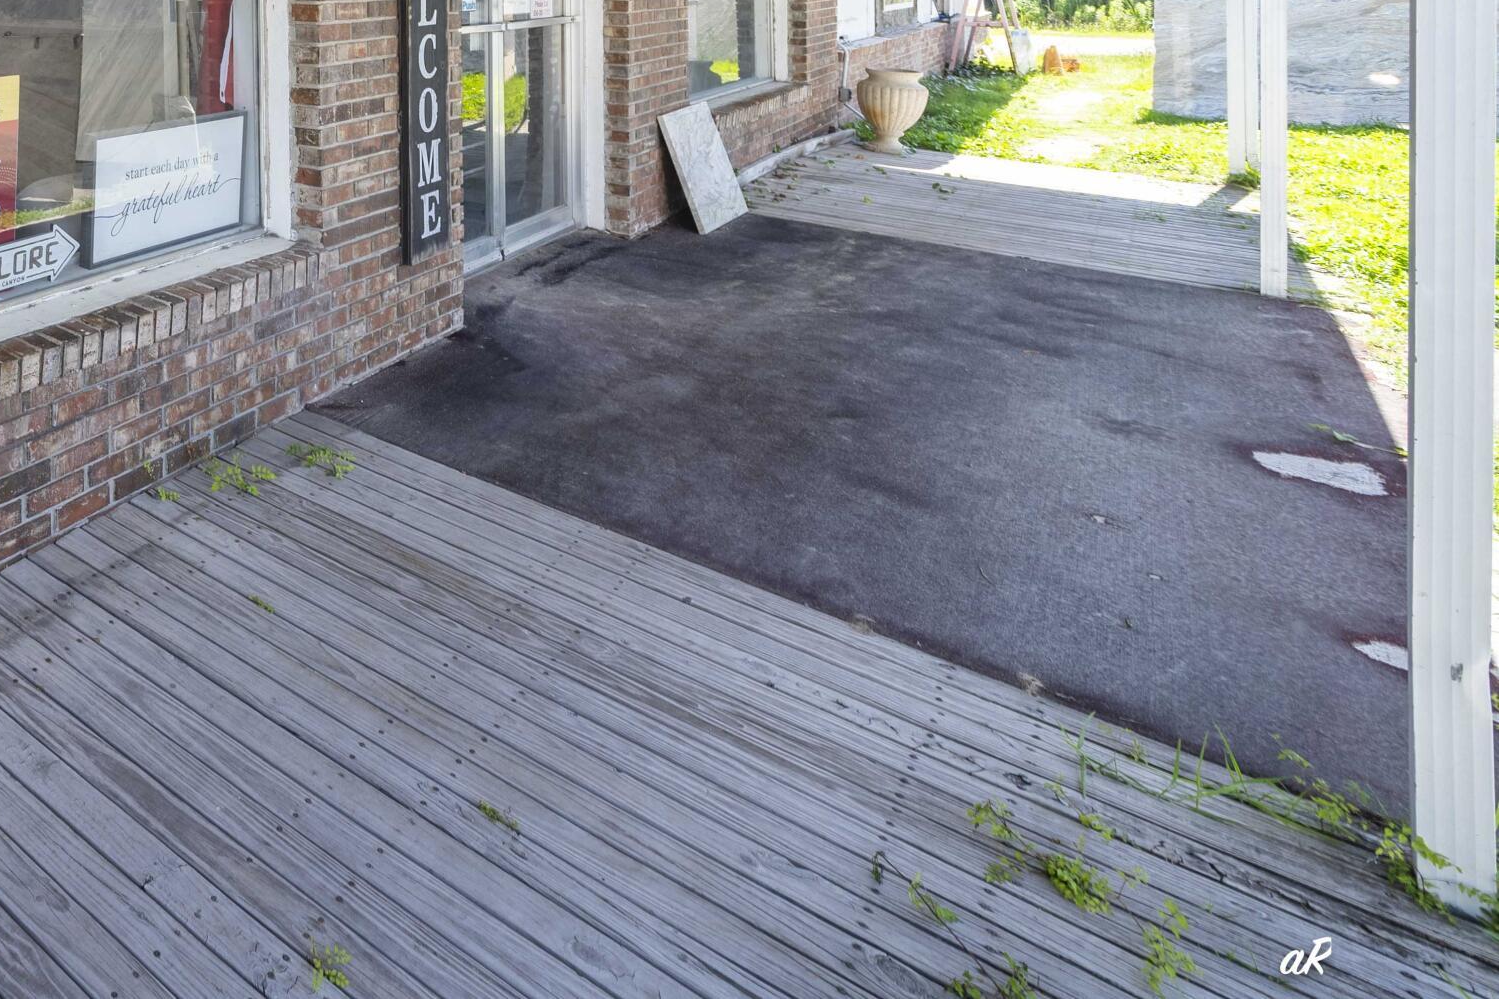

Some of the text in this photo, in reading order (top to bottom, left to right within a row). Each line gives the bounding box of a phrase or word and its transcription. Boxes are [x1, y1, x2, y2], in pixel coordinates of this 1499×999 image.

[125, 151, 219, 181] start each day with a
[110, 173, 221, 237] grateful heart
[1, 276, 26, 288] CANYON
